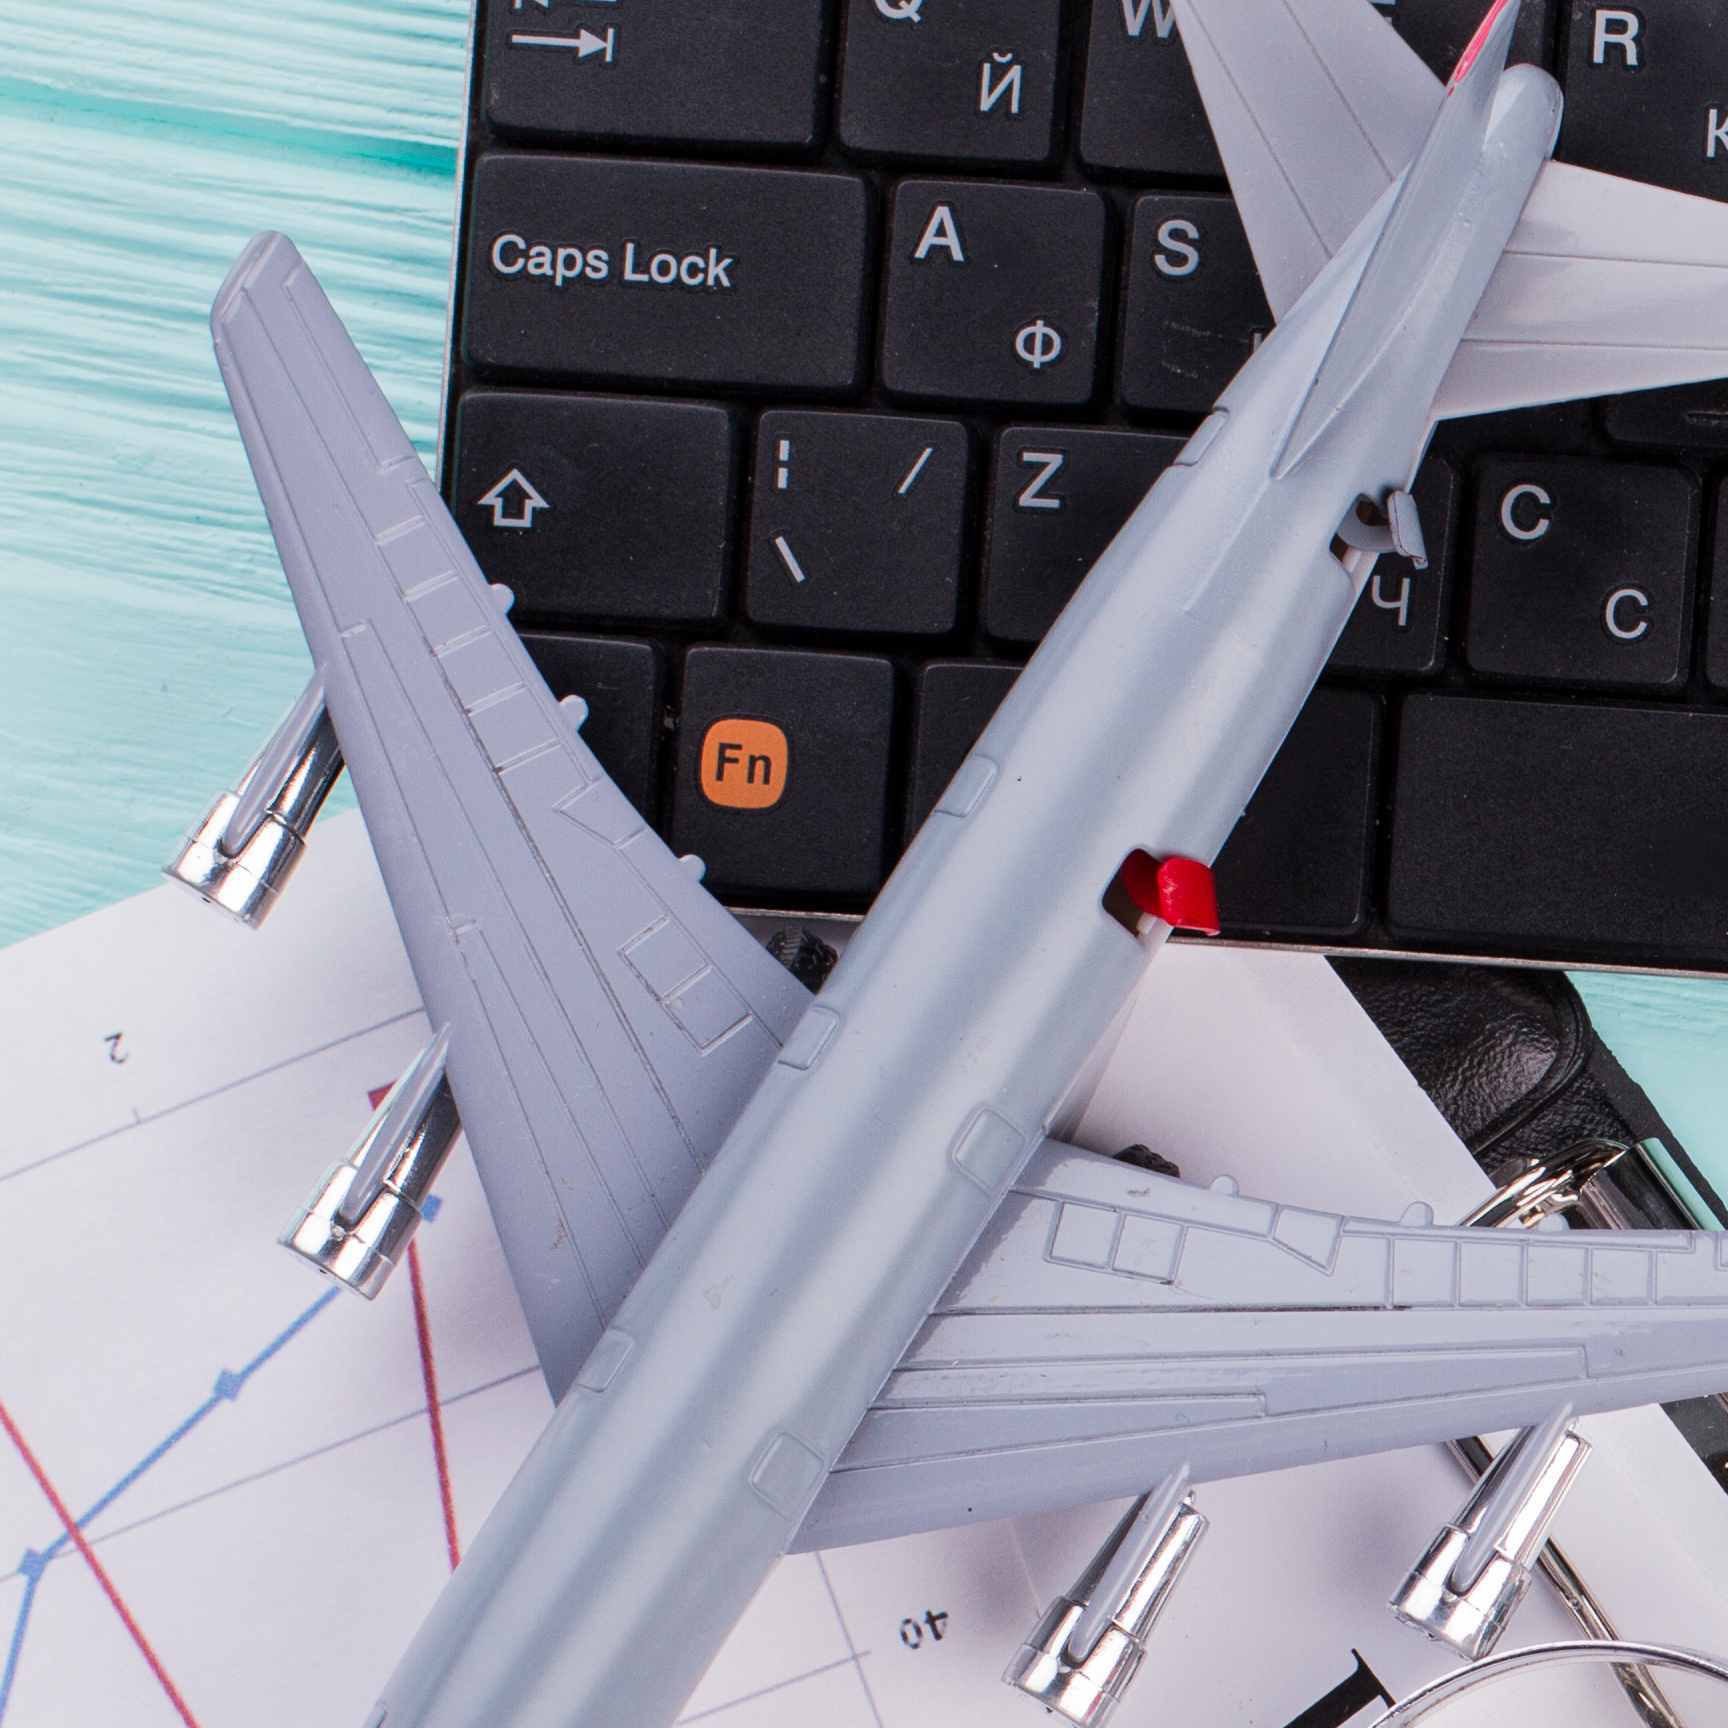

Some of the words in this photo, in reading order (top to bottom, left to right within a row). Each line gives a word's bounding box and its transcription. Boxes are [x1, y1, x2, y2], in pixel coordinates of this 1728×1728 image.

[1592, 9, 1639, 66] R
[979, 52, 1022, 114] Й
[491, 233, 609, 286] Caps
[623, 242, 733, 287] Lock
[914, 205, 964, 262] A
[1154, 219, 1199, 275] S
[1015, 319, 1061, 369] Ф
[1018, 451, 1063, 508] Z
[1501, 484, 1550, 540] C
[716, 738, 774, 786] Fn
